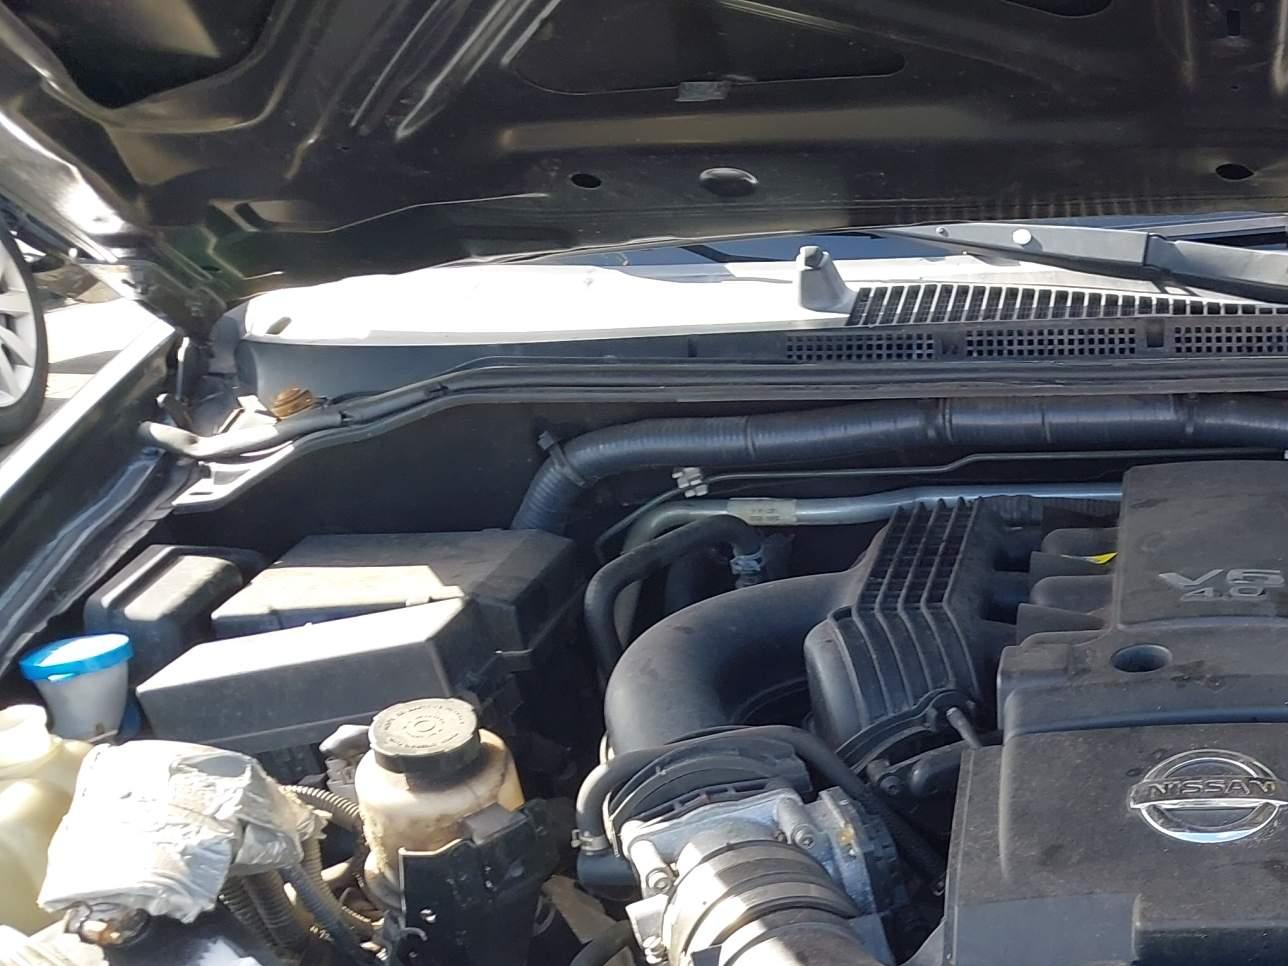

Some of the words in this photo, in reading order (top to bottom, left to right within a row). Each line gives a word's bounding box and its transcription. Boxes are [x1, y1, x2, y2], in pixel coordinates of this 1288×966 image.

[1158, 569, 1285, 589] V6
[1180, 586, 1268, 601] 4.0
[1148, 779, 1277, 795] NISSAN
